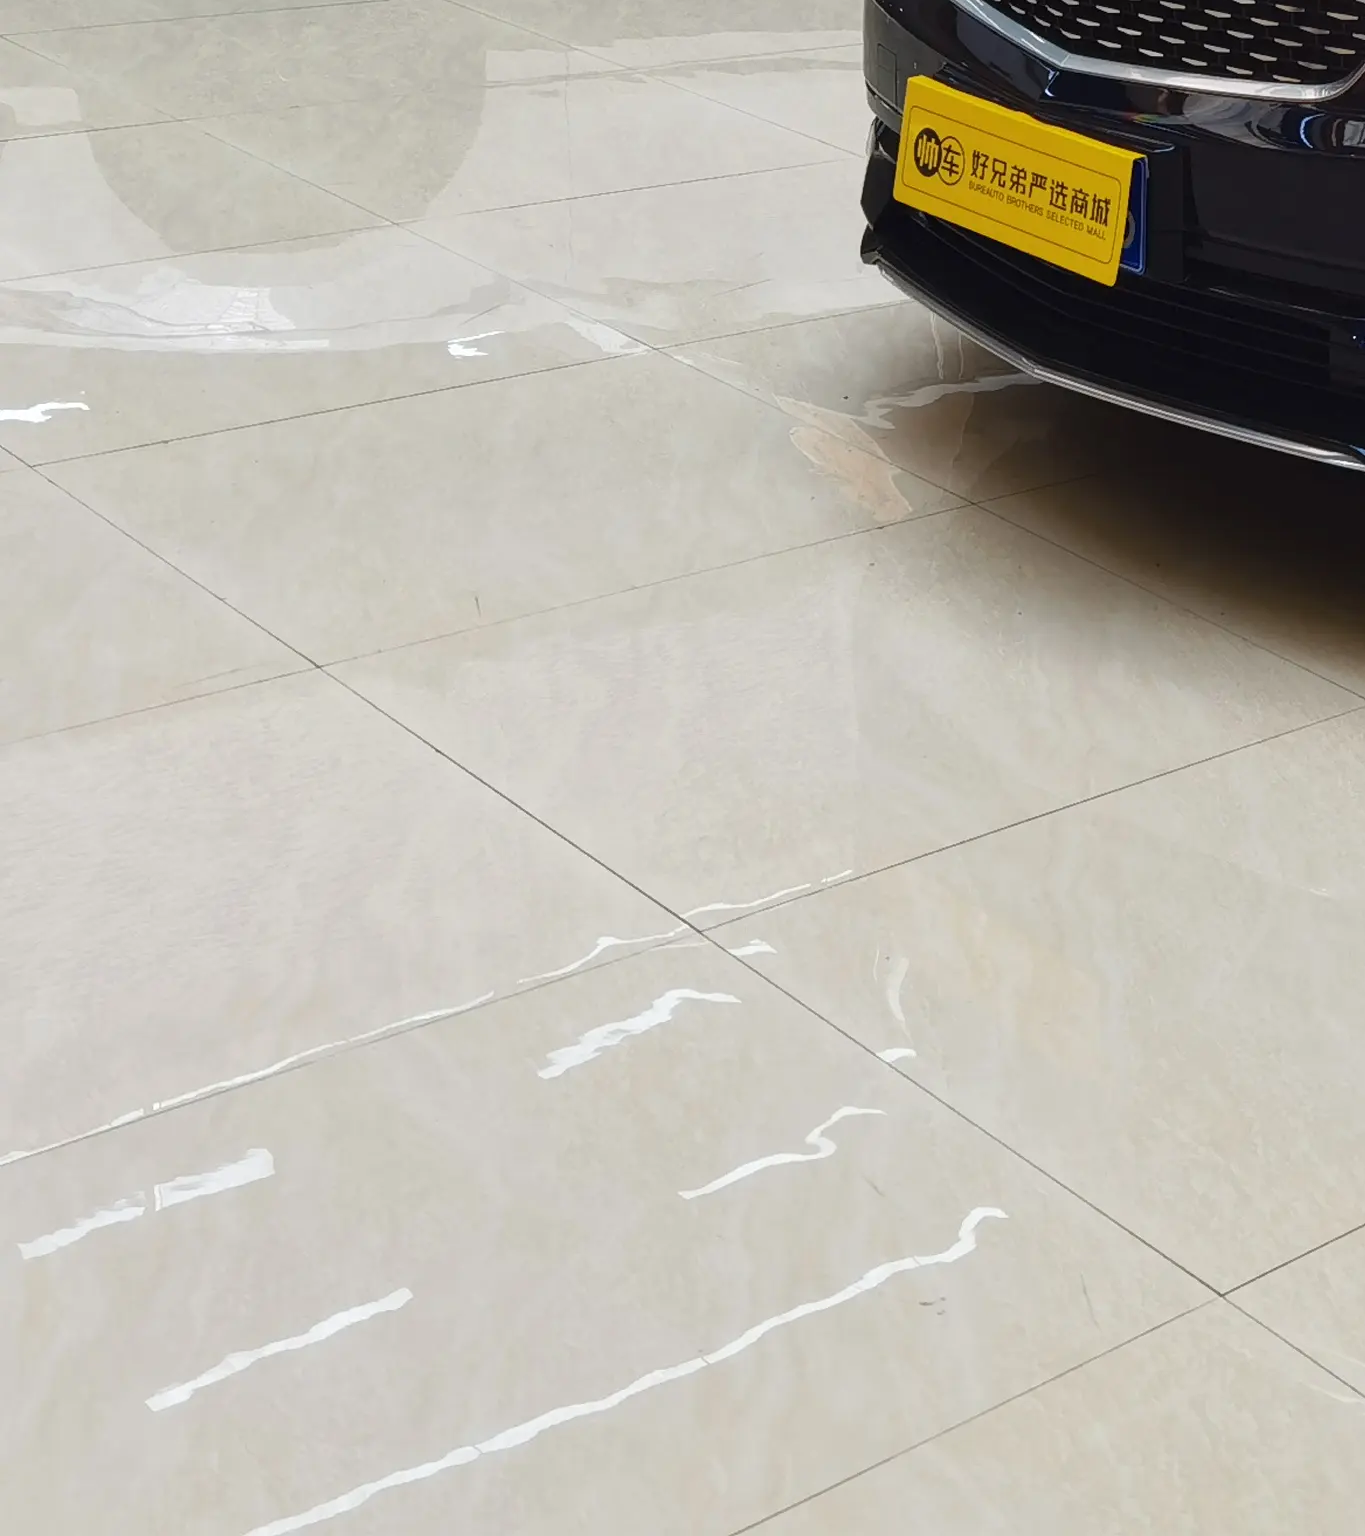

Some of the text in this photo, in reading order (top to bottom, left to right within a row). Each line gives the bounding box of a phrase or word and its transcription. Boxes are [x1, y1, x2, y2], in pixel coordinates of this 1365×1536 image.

[916, 131, 1112, 228] 帅车 好兄弟严选商城
